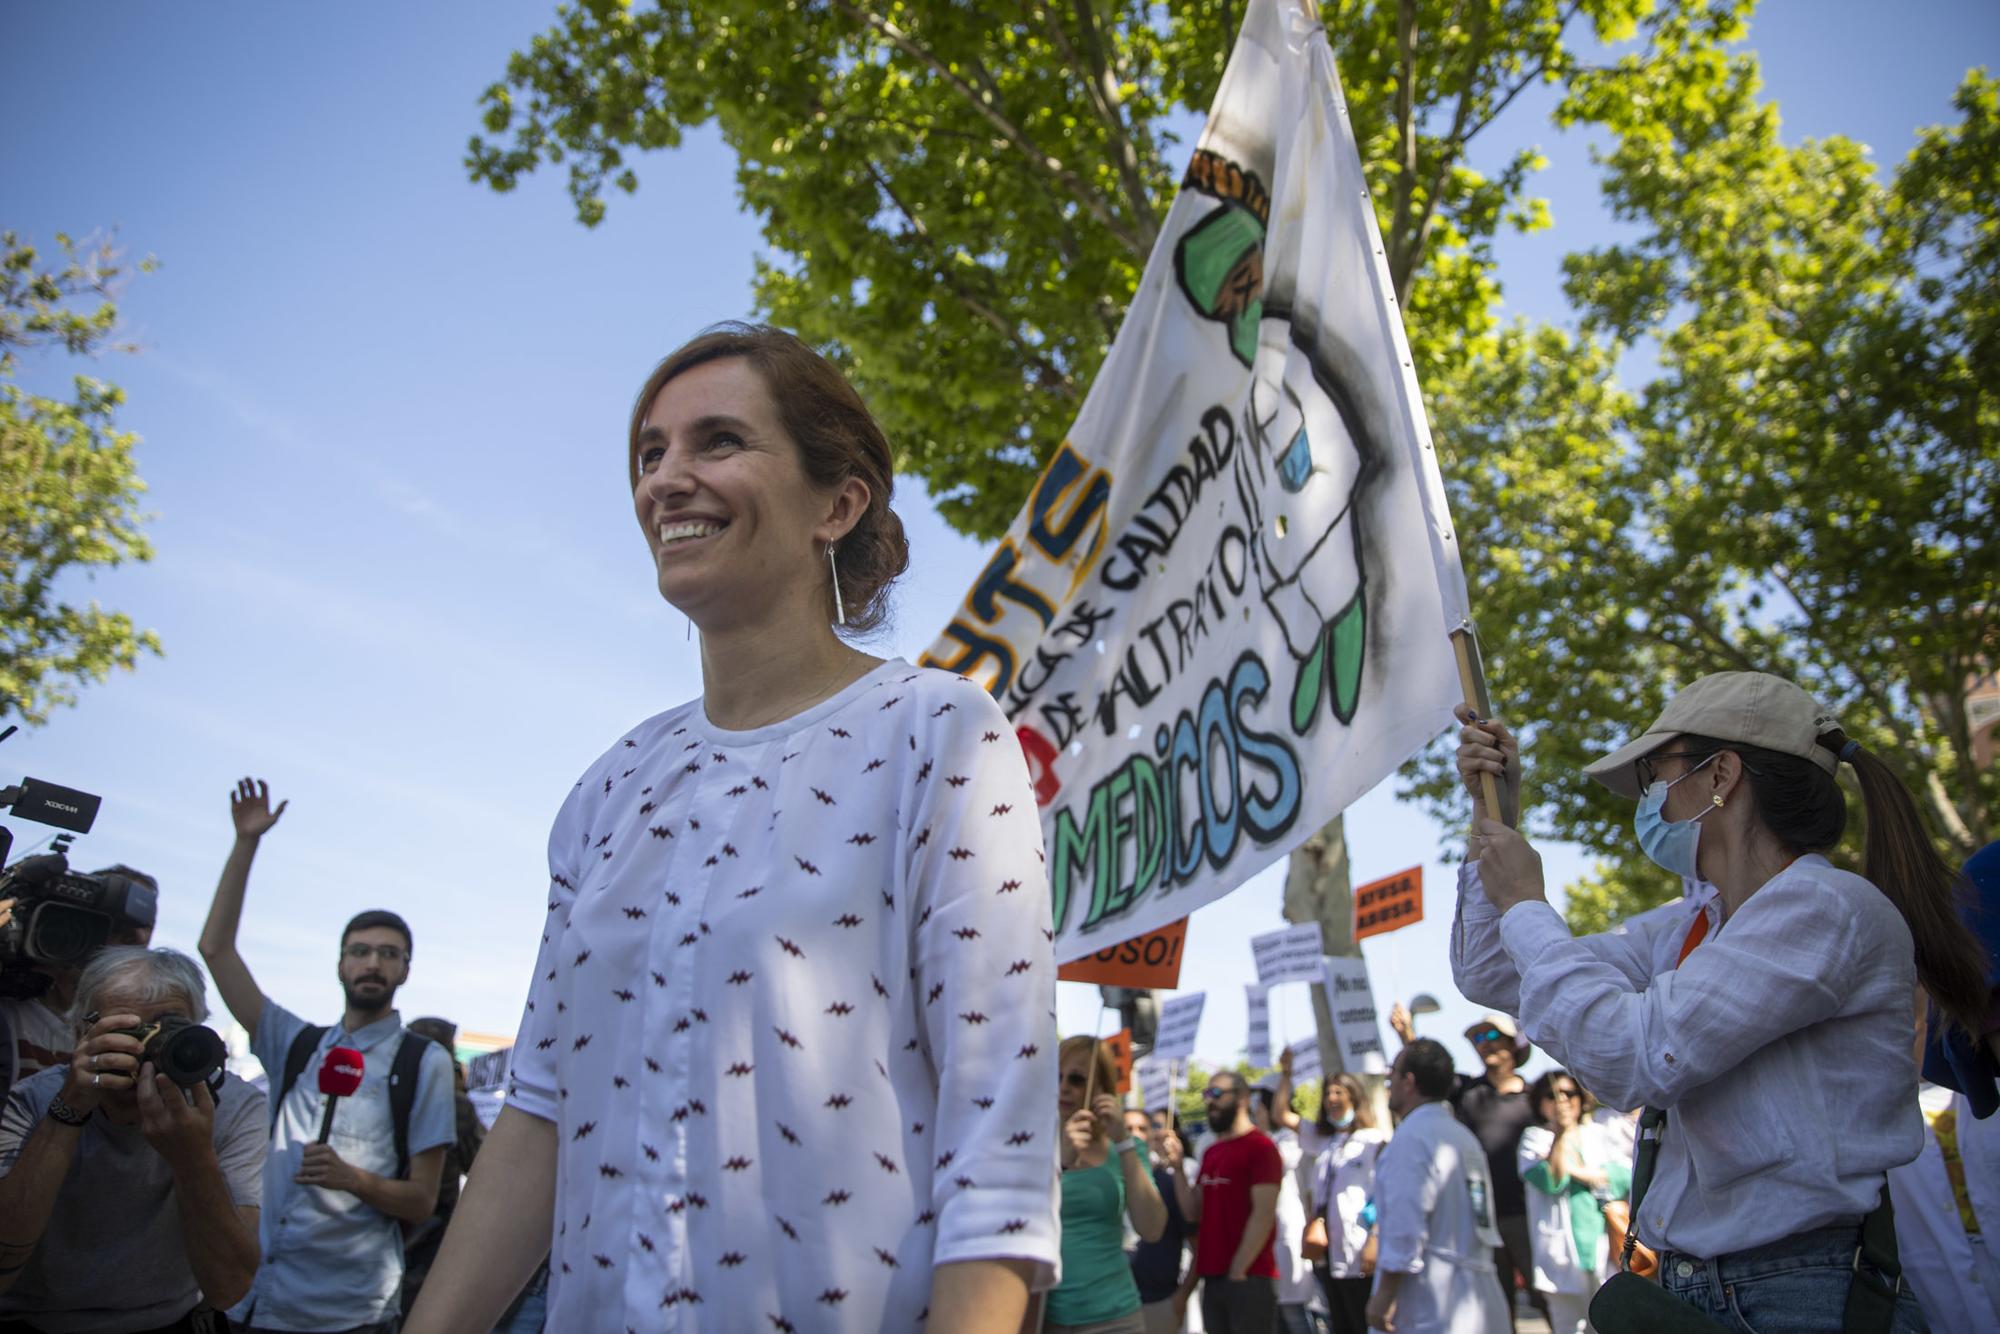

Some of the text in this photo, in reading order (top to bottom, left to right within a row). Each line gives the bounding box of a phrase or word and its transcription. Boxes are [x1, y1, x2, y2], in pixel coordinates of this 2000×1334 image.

[1052, 600, 1116, 648] DE
[1100, 404, 1236, 592] CALIDAD
[1040, 691, 1090, 752] DE
